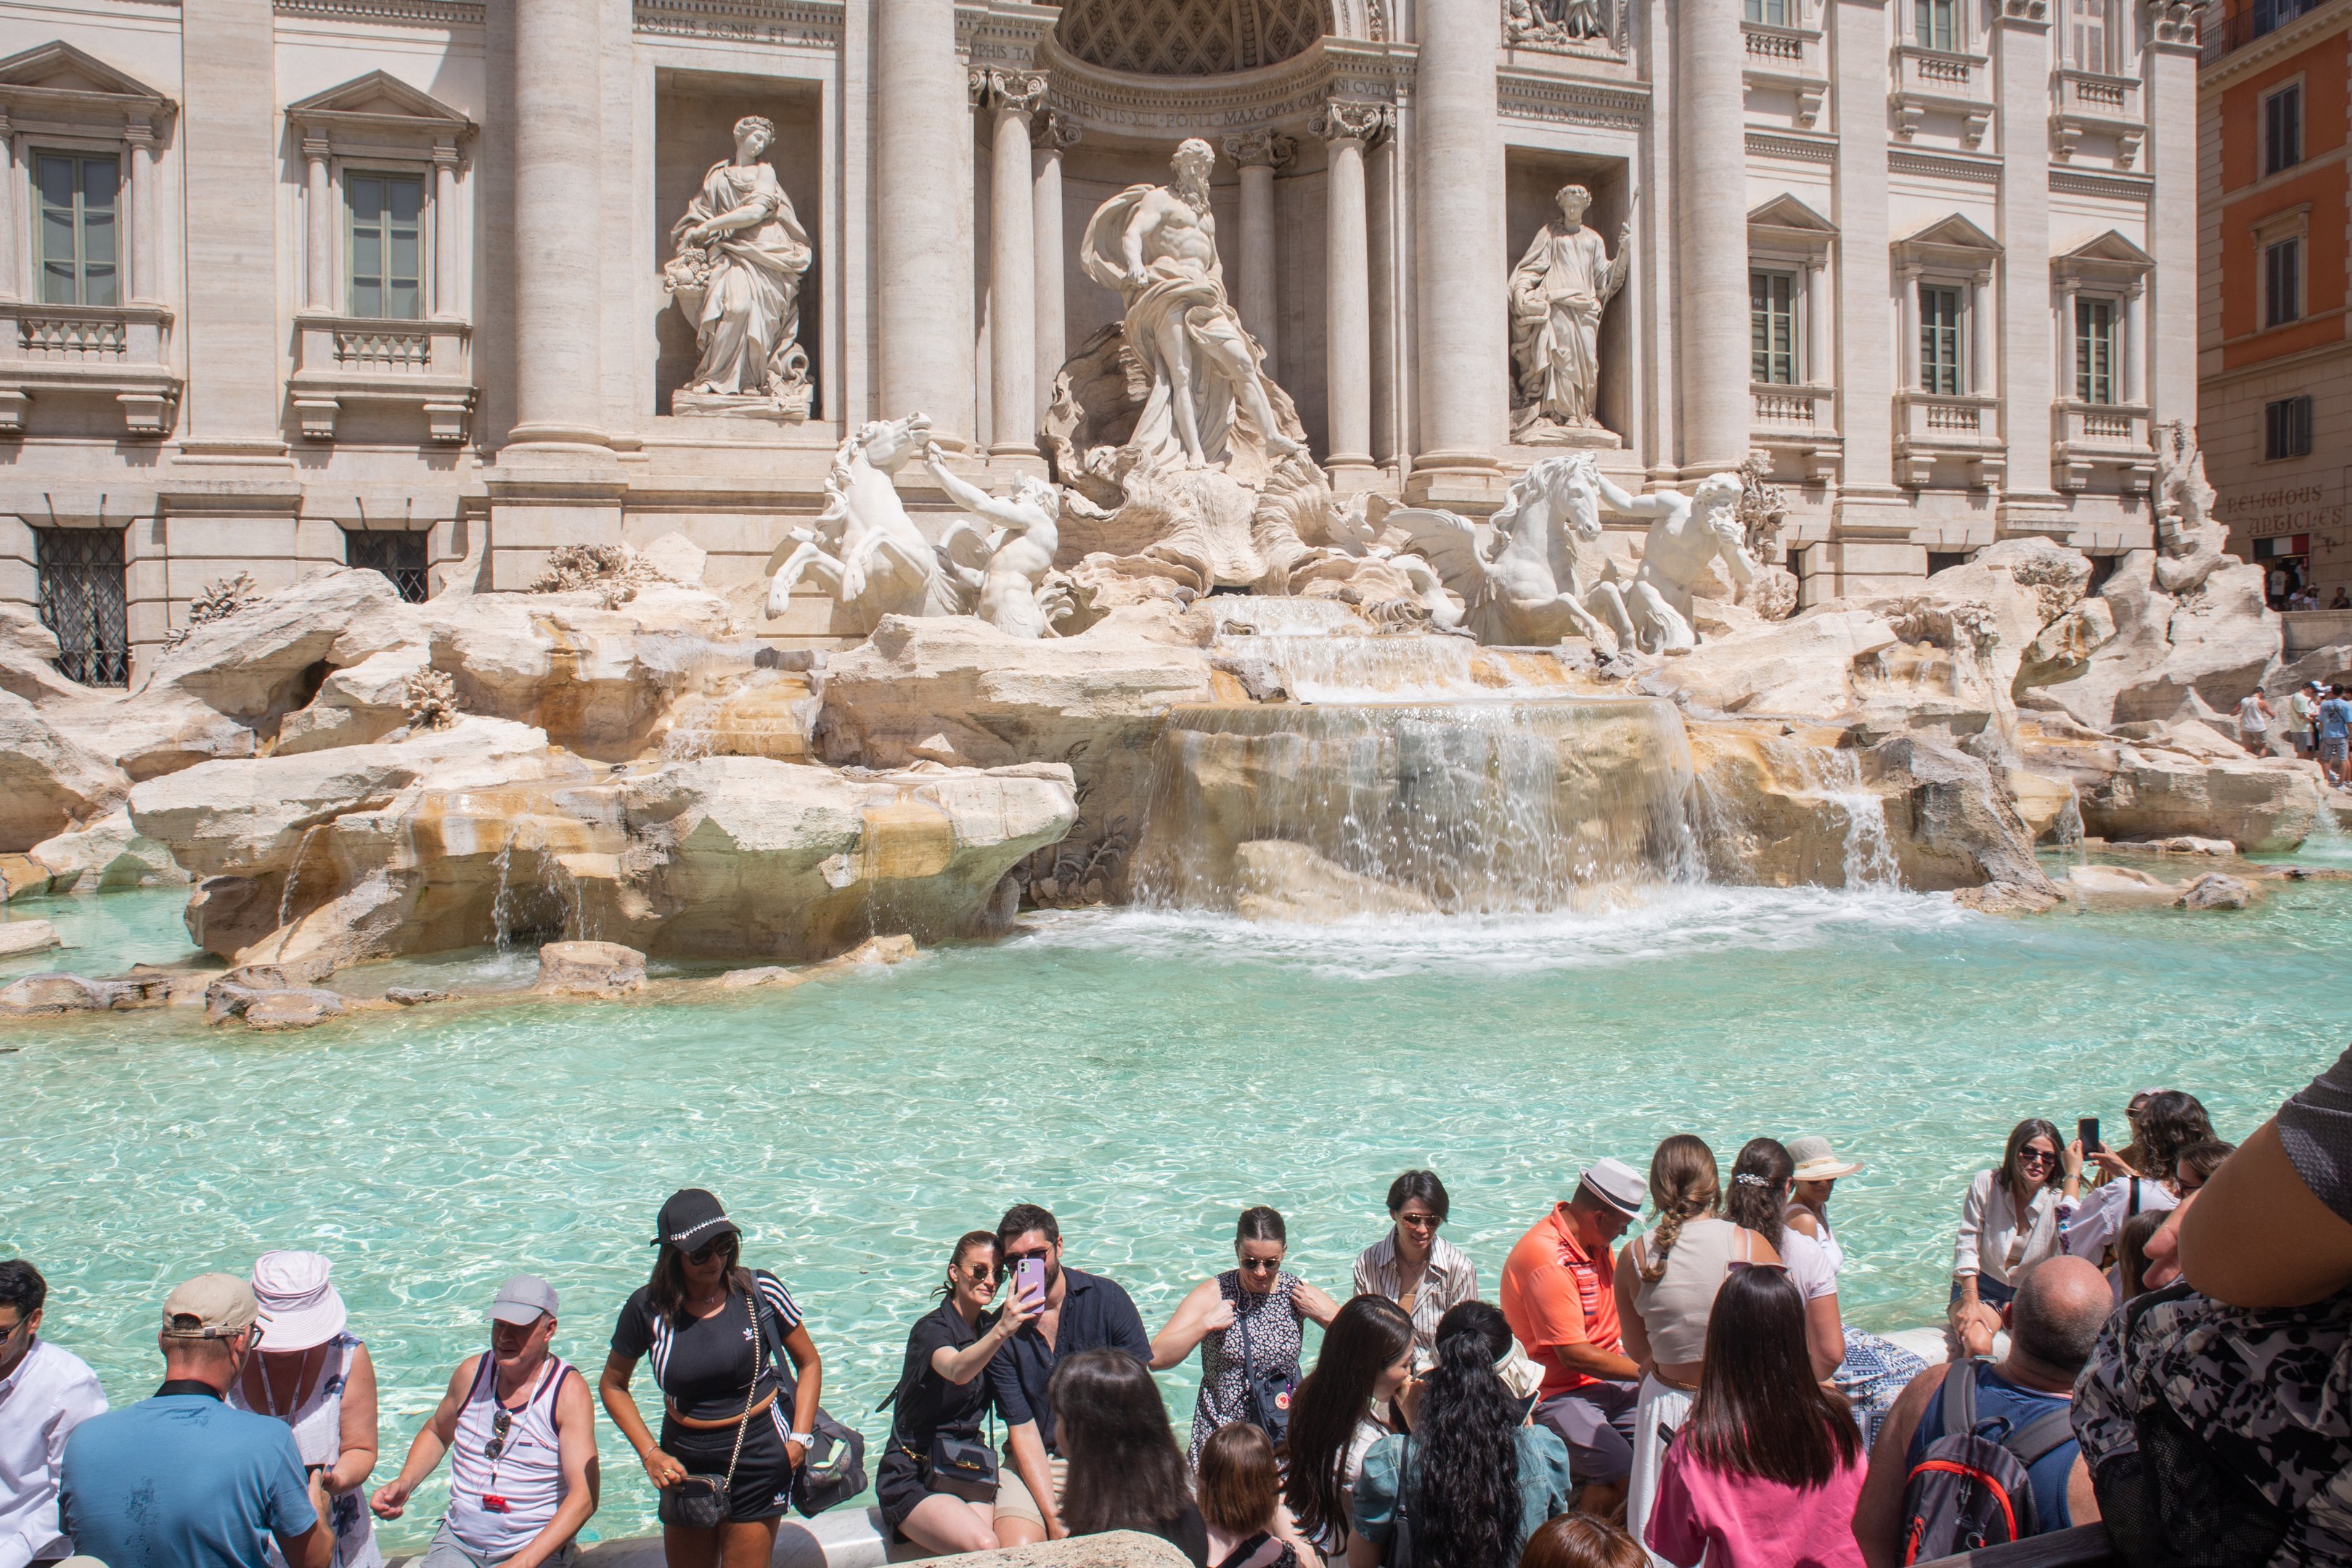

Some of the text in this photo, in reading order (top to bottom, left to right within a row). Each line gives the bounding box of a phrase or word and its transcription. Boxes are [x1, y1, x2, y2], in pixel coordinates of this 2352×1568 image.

[637, 16, 838, 46] POSITIS SIGNIS ET ANA
[1049, 89, 1126, 123] CLEMENTIS
[1166, 113, 1214, 127] PONT
[1224, 107, 1257, 125] MAX
[1265, 100, 1294, 118] OPVS
[1299, 88, 1321, 107] CVM
[2226, 484, 2322, 514] RELIGIOUS
[2247, 507, 2343, 534] ARTICLES
